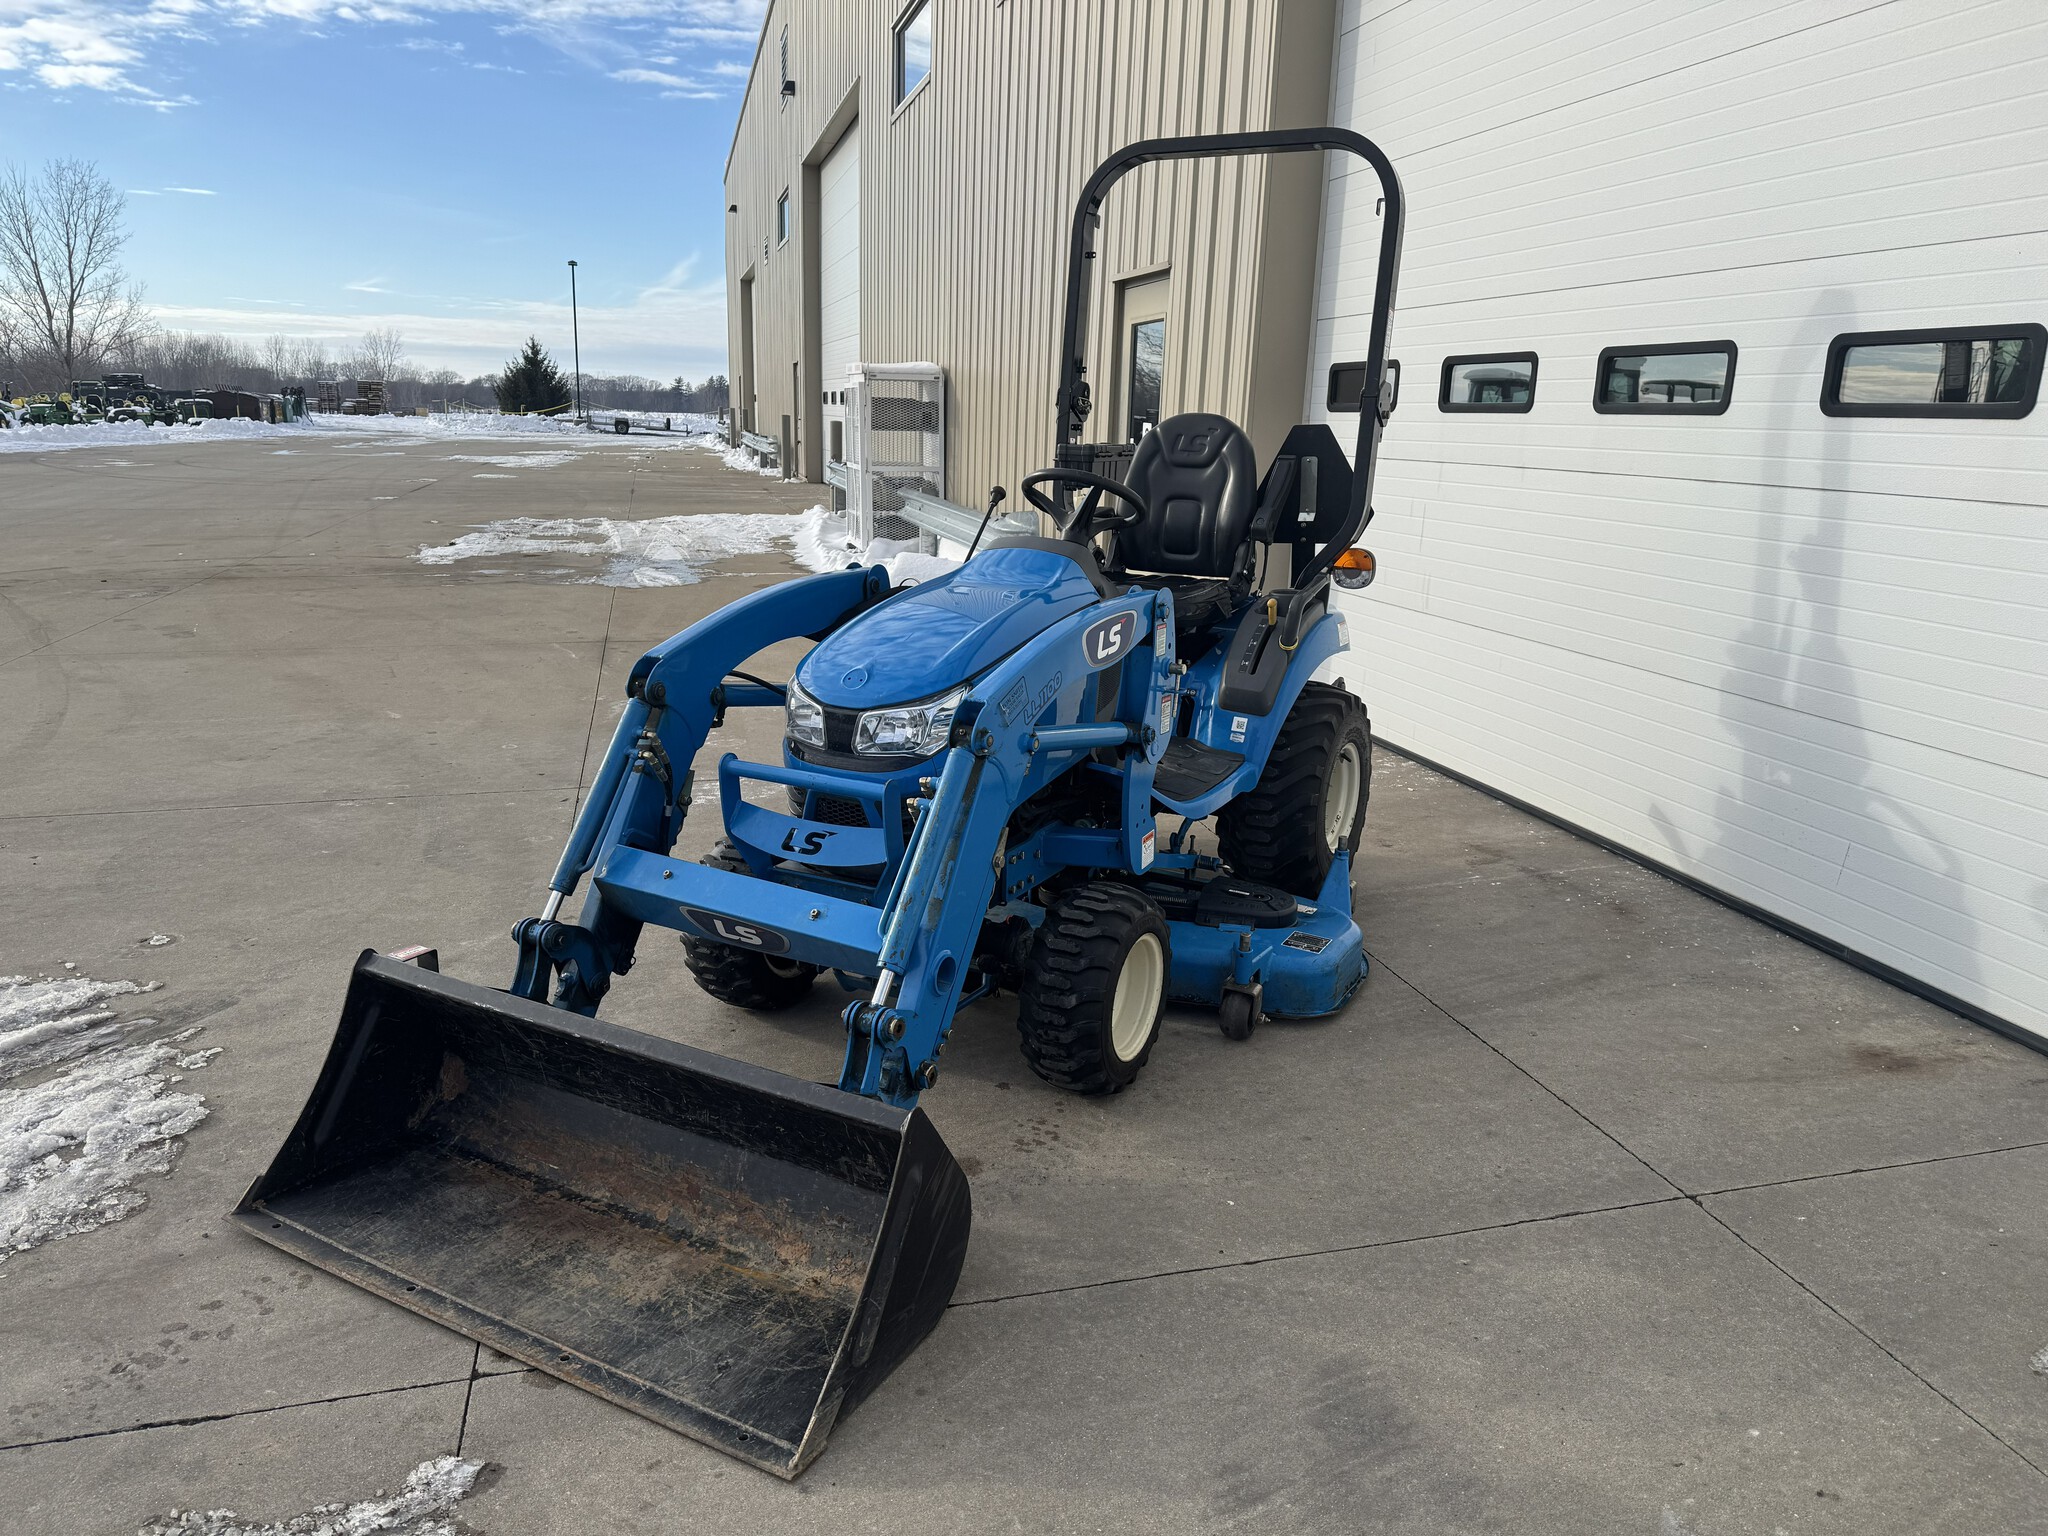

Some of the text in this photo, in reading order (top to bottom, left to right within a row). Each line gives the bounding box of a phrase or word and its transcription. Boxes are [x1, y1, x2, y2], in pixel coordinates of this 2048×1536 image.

[1171, 431, 1212, 457] LS
[1097, 622, 1122, 660] LS
[780, 827, 827, 856] LS
[713, 919, 763, 945] LS
